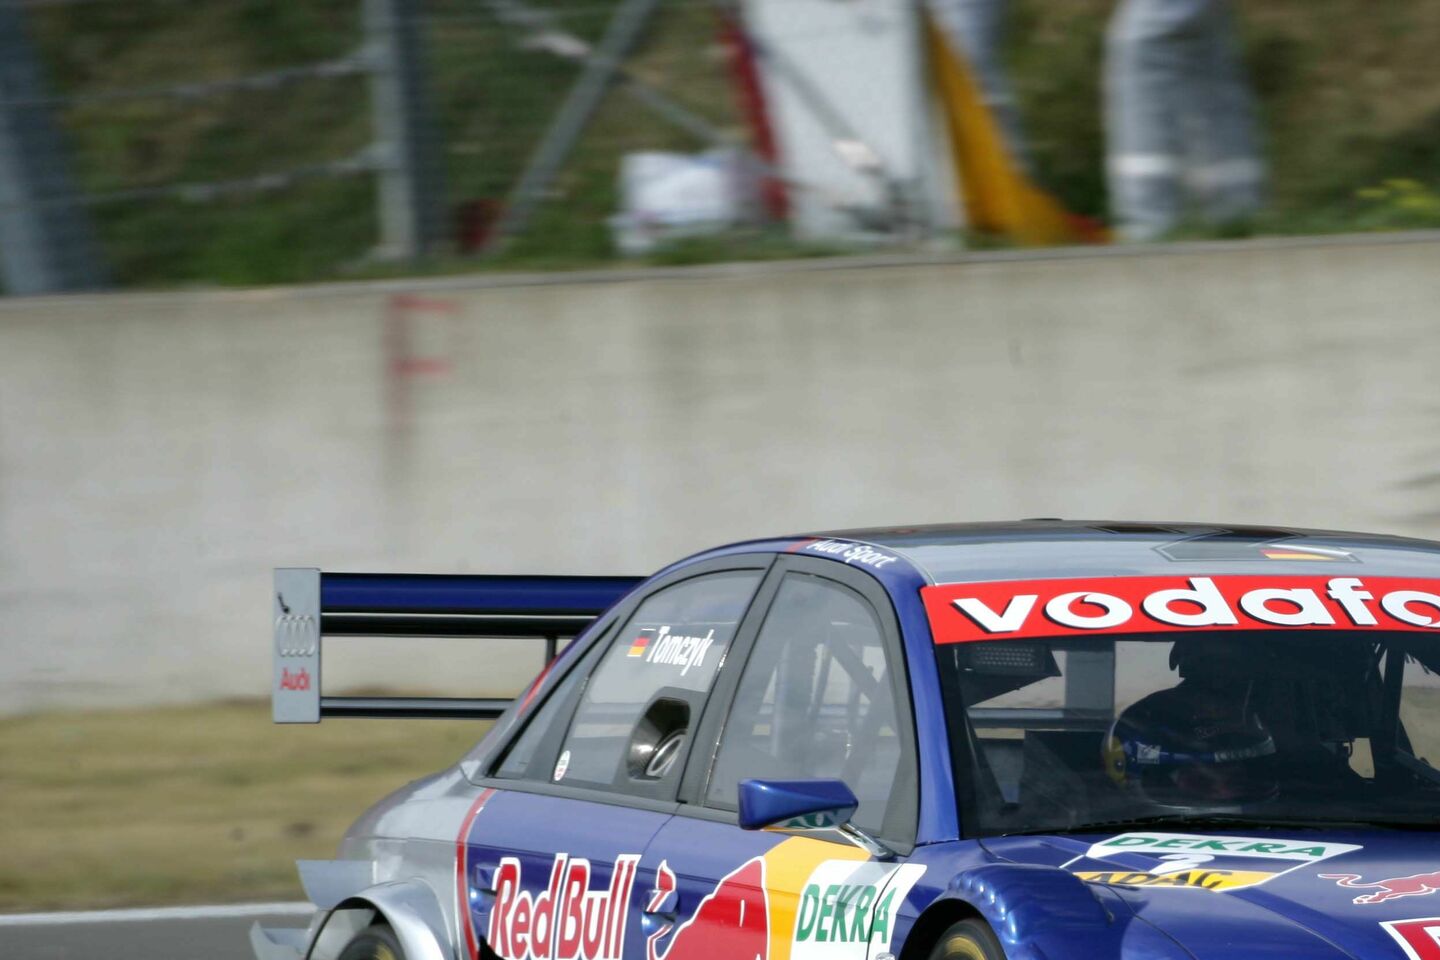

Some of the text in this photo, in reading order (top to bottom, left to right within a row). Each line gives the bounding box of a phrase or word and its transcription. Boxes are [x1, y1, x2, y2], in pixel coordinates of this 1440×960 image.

[843, 545, 898, 568] Sport
[646, 626, 715, 676] Tomczyk
[279, 667, 312, 691] Audi
[1102, 836, 1327, 857] DEKRA
[1082, 870, 1233, 889] ADAC
[796, 884, 897, 943] DEKRA
